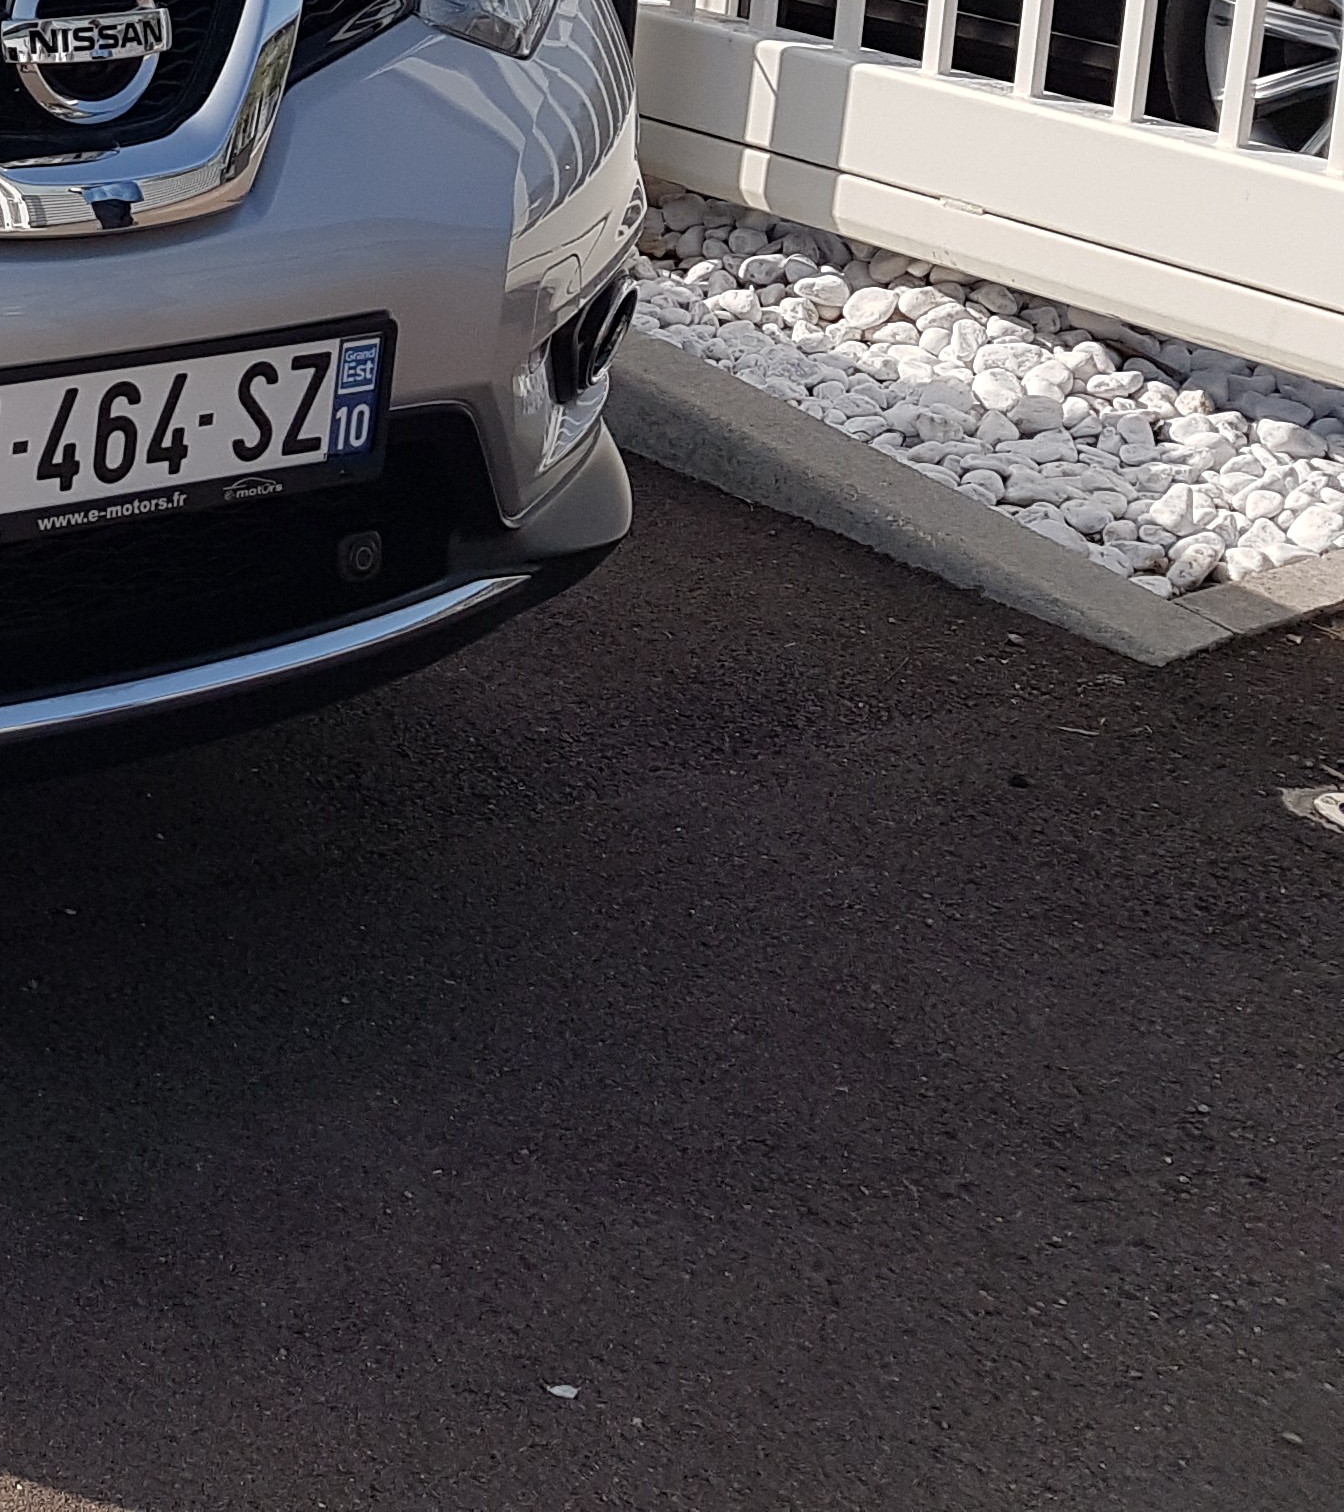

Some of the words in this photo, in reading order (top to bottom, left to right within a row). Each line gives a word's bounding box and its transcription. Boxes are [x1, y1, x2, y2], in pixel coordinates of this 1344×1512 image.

[29, 20, 164, 55] NISSAN
[342, 360, 374, 383] Est
[345, 347, 376, 362] Grand
[335, 403, 370, 450] 10
[37, 490, 188, 532] www.e-motors.fr
